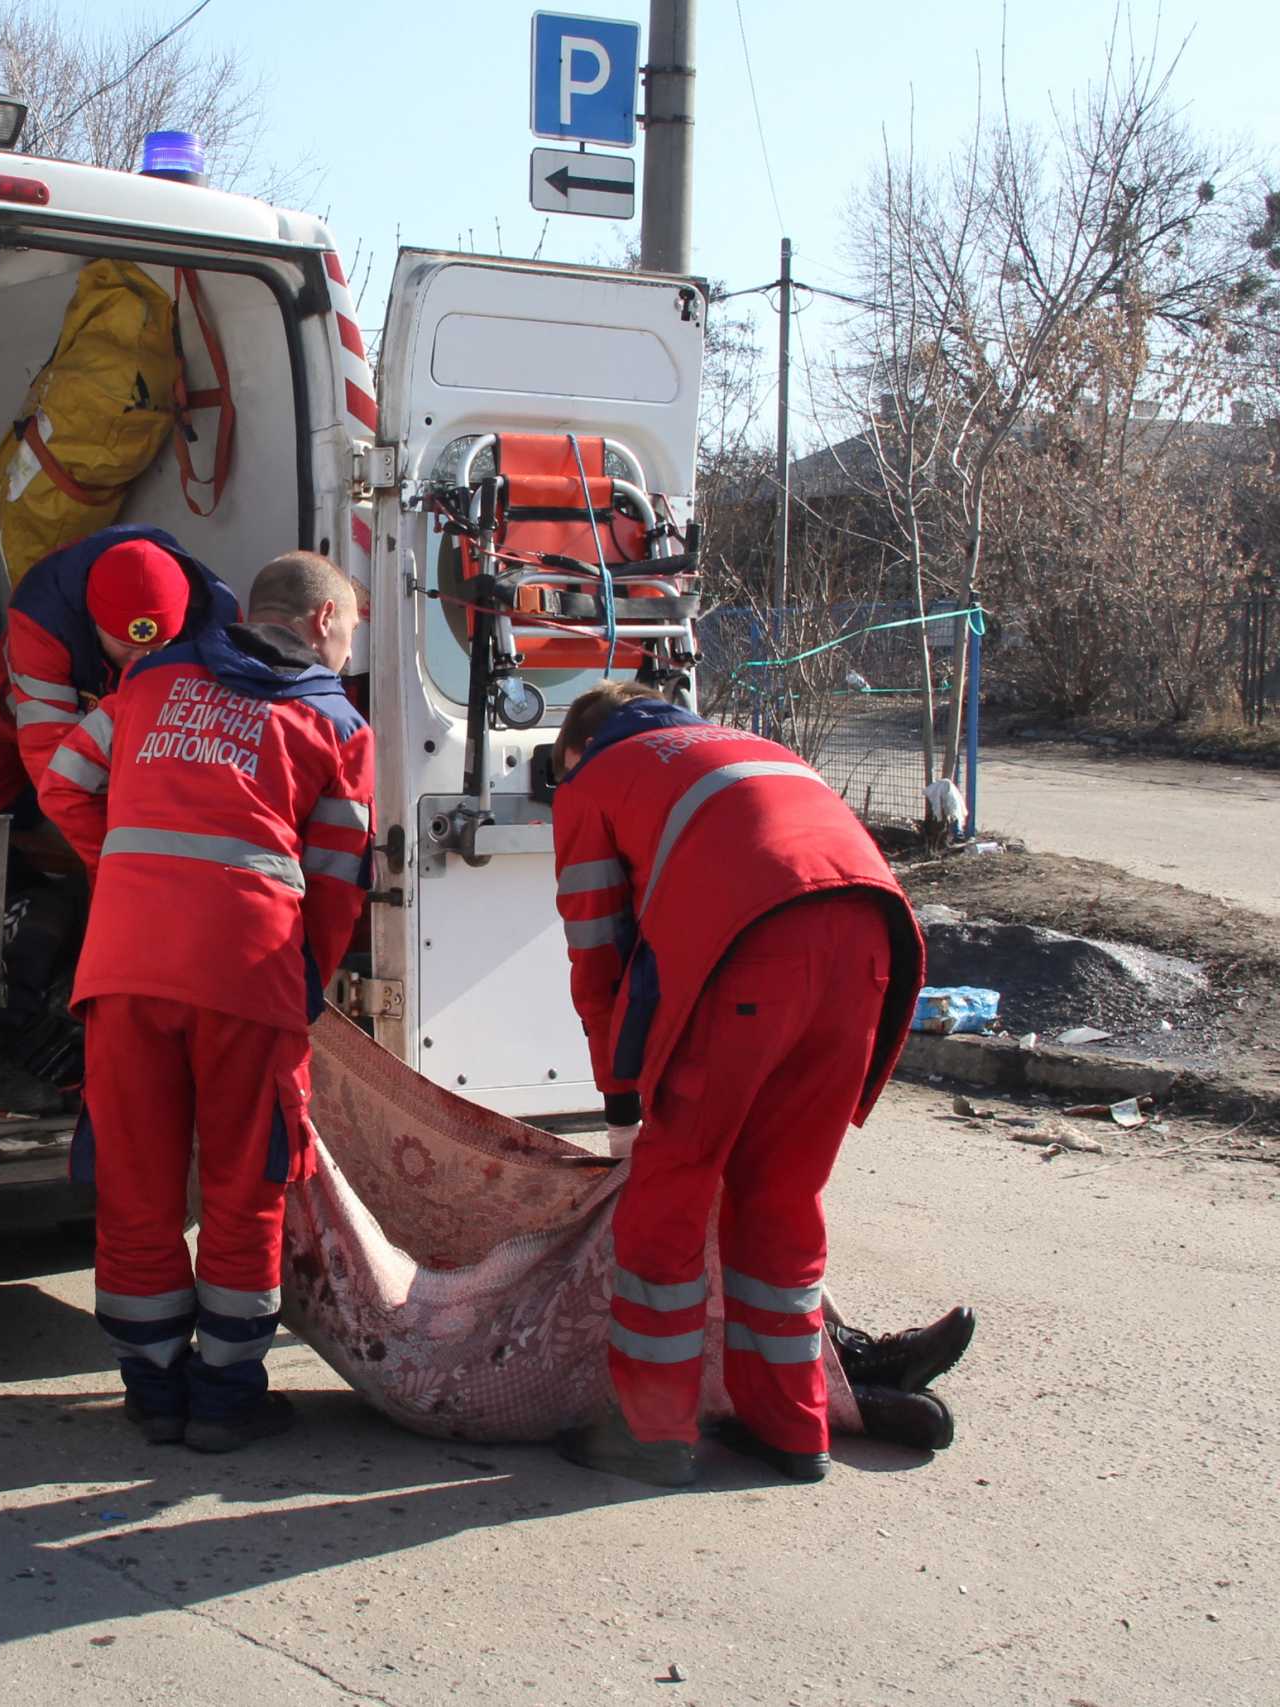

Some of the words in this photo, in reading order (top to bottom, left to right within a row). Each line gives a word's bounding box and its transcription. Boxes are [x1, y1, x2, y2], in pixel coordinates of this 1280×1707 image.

[560, 35, 611, 125] P
[156, 702, 264, 747] МЕДИЧНА
[136, 732, 258, 778] ДОПОМОГА
